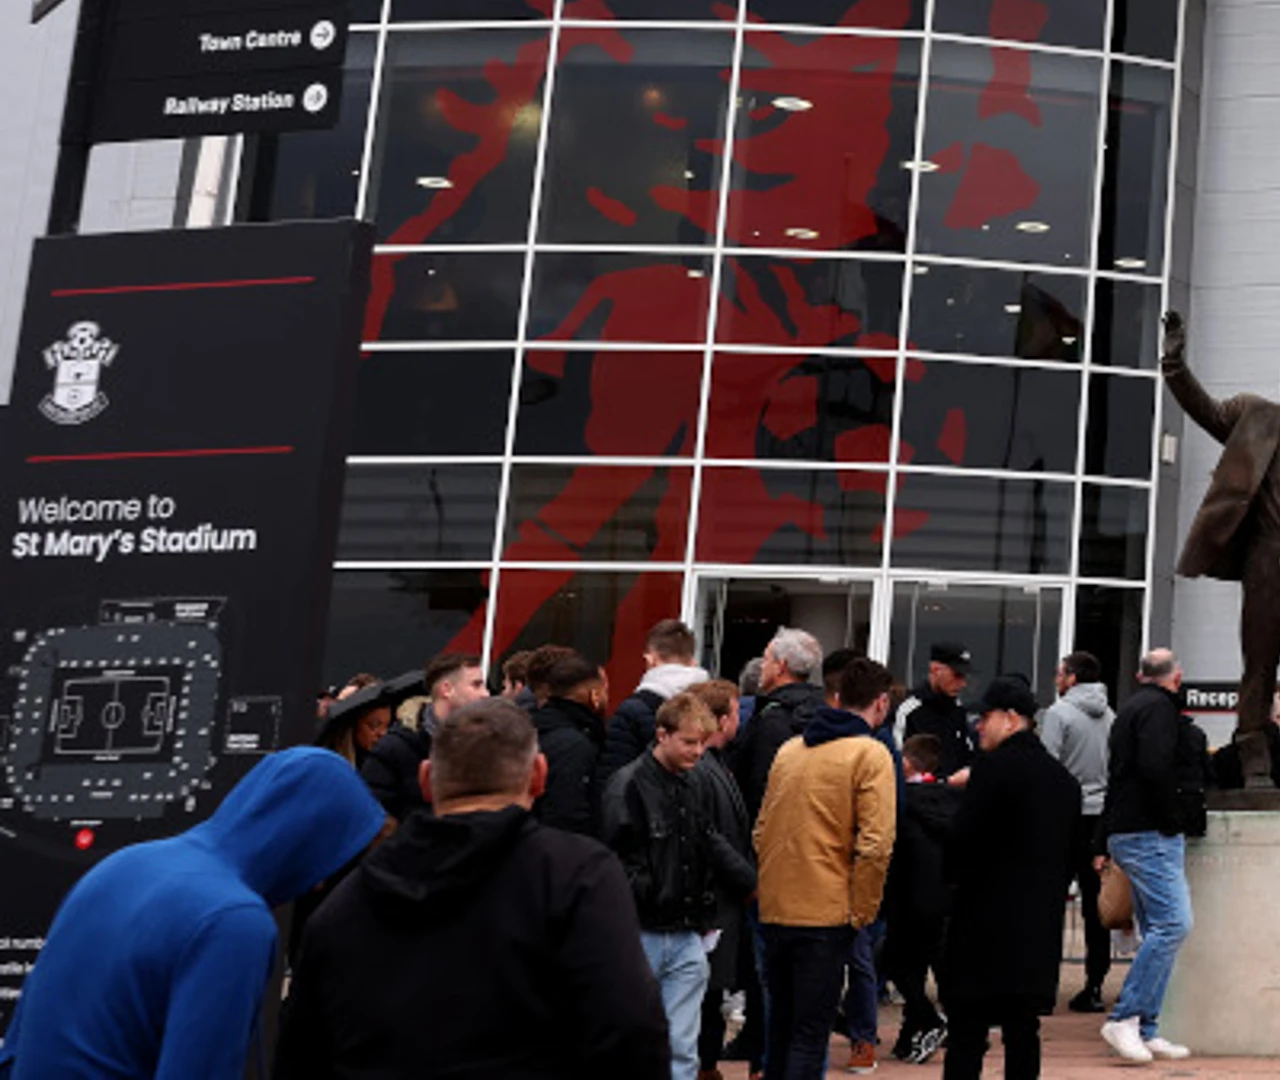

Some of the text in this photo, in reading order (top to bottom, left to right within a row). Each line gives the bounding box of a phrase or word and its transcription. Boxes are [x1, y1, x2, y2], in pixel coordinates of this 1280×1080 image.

[199, 30, 303, 52] Town Centre
[163, 91, 294, 115] Railway Station
[18, 494, 175, 524] Welcome to
[12, 523, 257, 562] St Mary's Stadium
[1186, 688, 1240, 710] Recep
